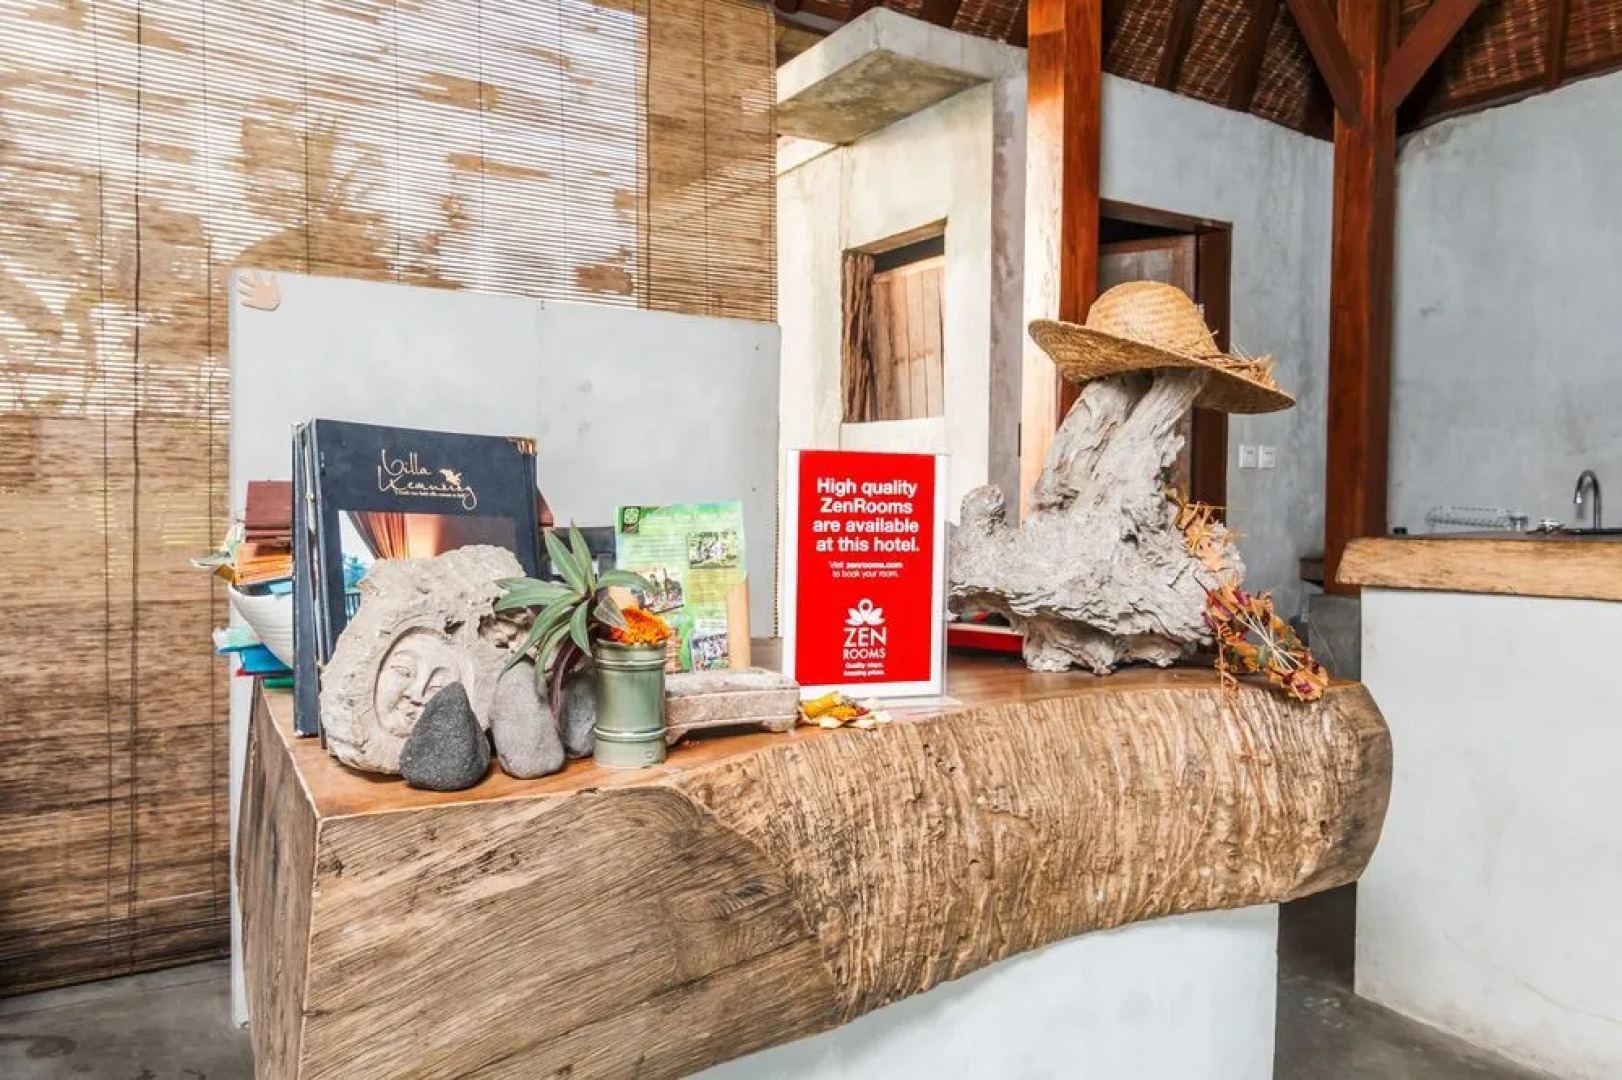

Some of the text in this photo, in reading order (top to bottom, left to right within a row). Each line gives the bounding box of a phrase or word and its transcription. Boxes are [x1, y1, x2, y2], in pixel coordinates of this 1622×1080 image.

[381, 448, 432, 476] Villa
[817, 477, 918, 498] High quality
[820, 497, 913, 514] ZenRooms
[813, 517, 919, 533] are available
[816, 536, 920, 552] at this hotel.
[829, 560, 903, 570] Visit zenrooms.com
[832, 570, 900, 580] to book your room.
[843, 626, 887, 648] ZEN
[843, 648, 886, 660] ROOMS
